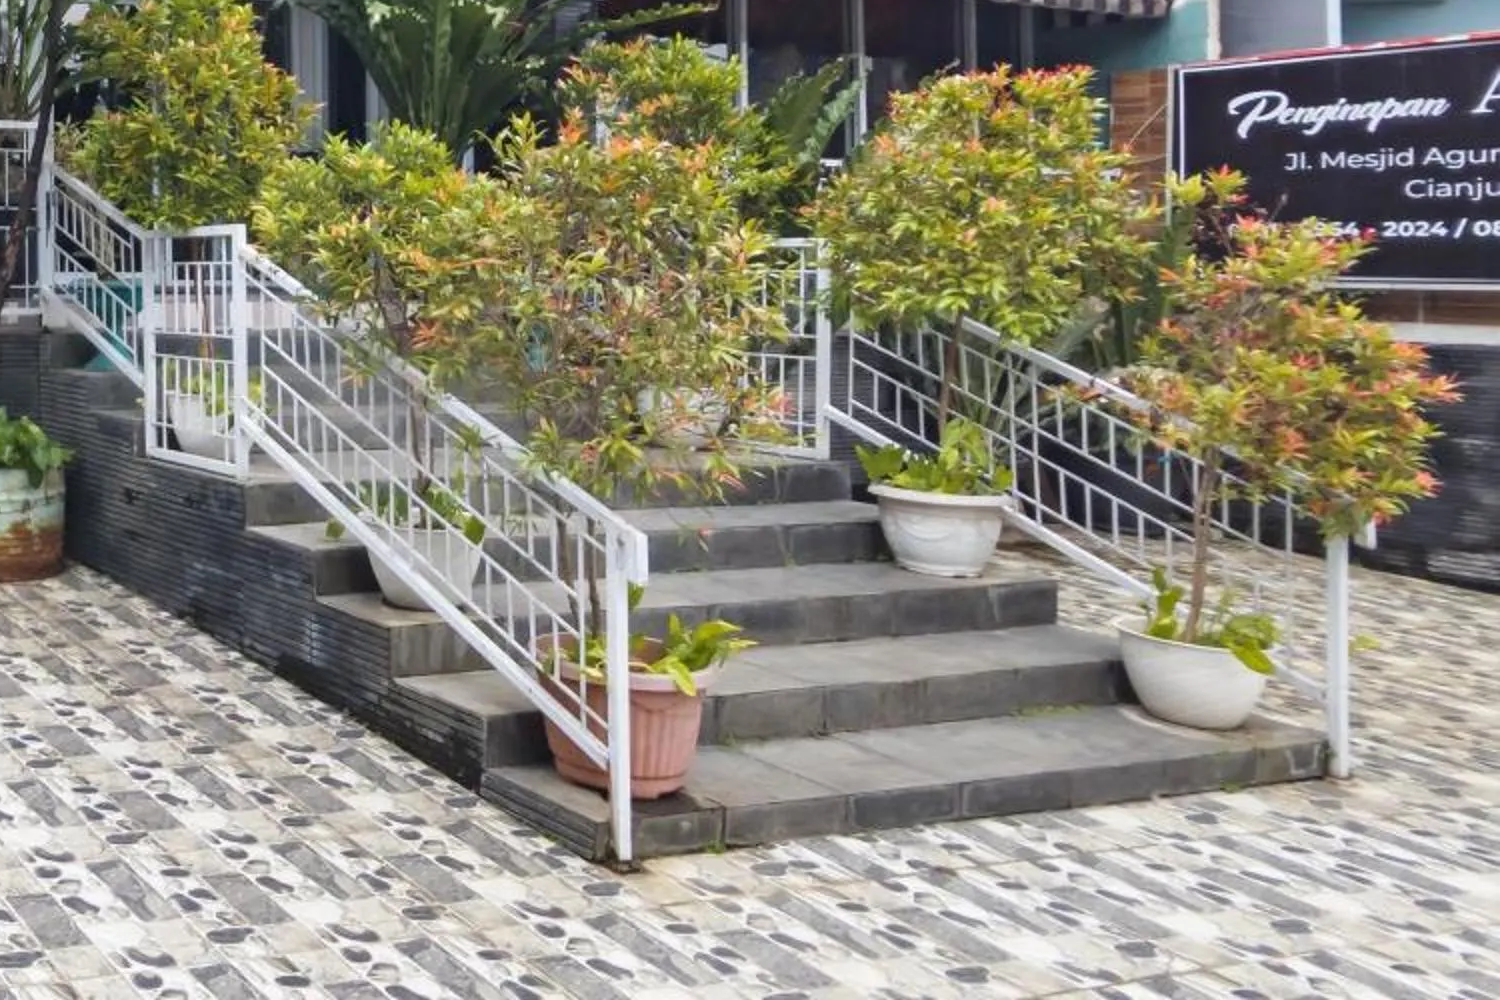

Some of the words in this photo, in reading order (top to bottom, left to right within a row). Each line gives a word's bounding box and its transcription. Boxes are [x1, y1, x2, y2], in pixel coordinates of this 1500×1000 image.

[1227, 90, 1450, 139] Penginapan
[1284, 152, 1313, 171] Jl.
[1320, 147, 1414, 172] Mesjid
[1382, 220, 1449, 237] 2024
